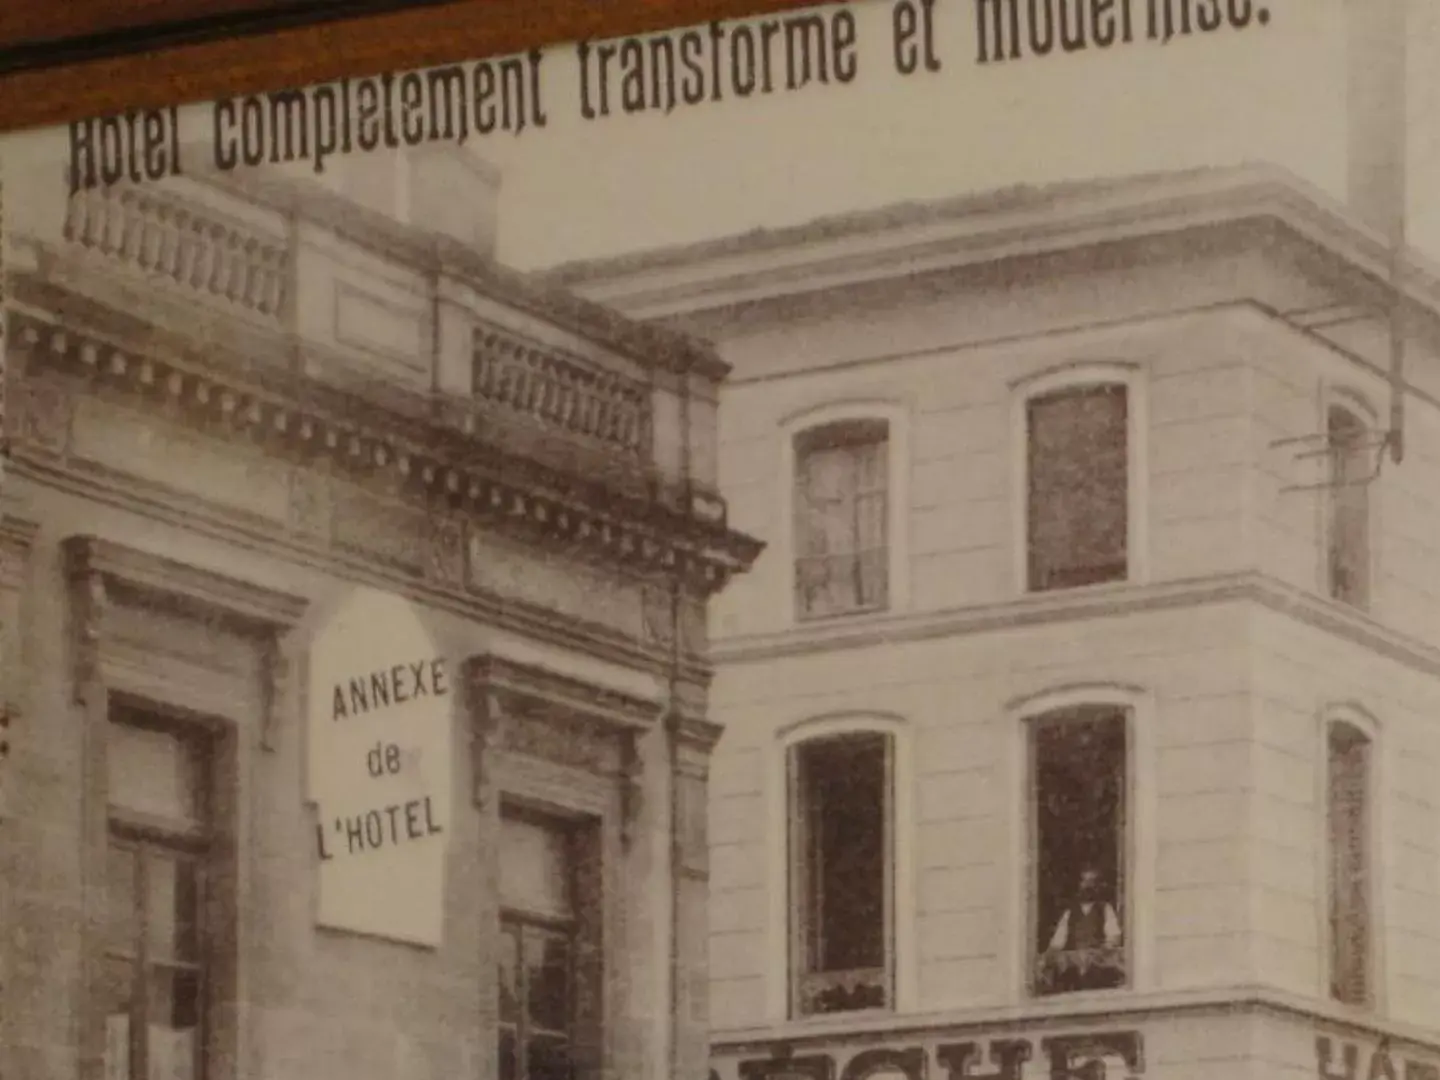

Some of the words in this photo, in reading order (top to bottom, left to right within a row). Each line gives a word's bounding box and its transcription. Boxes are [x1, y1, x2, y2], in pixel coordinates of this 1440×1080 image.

[892, 0, 941, 75] et
[331, 658, 449, 721] ANNEXE
[366, 741, 402, 778] de
[315, 796, 443, 861] L'HOTEL
